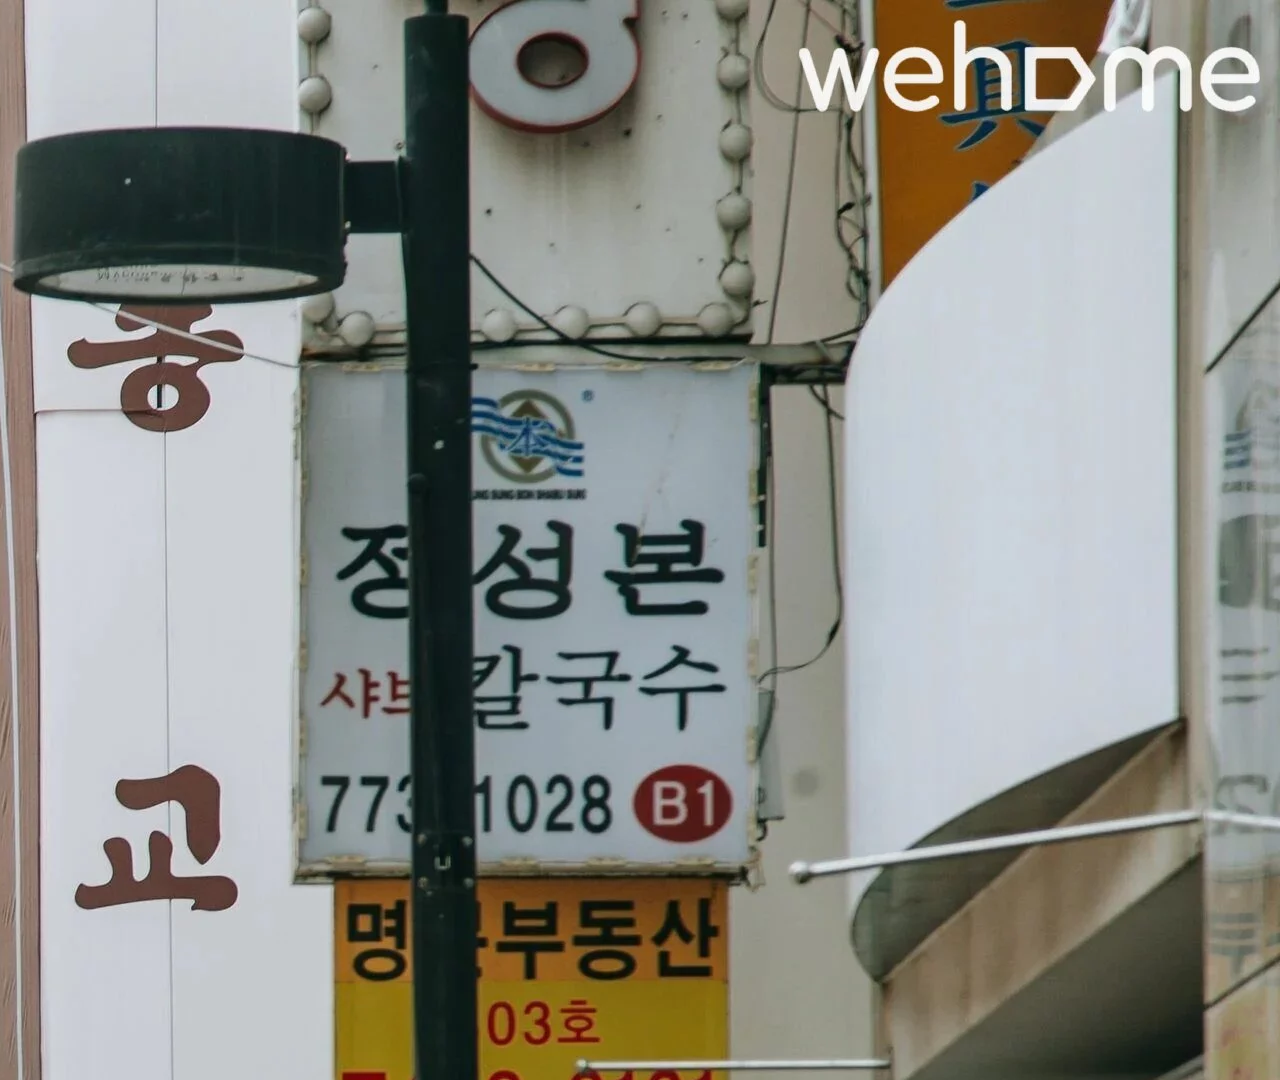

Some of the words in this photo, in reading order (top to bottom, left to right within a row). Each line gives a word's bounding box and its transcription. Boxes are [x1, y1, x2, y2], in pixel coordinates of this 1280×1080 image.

[472, 644, 728, 732] 칼국수
[652, 780, 716, 827] B1
[347, 897, 719, 982] 명부동산
